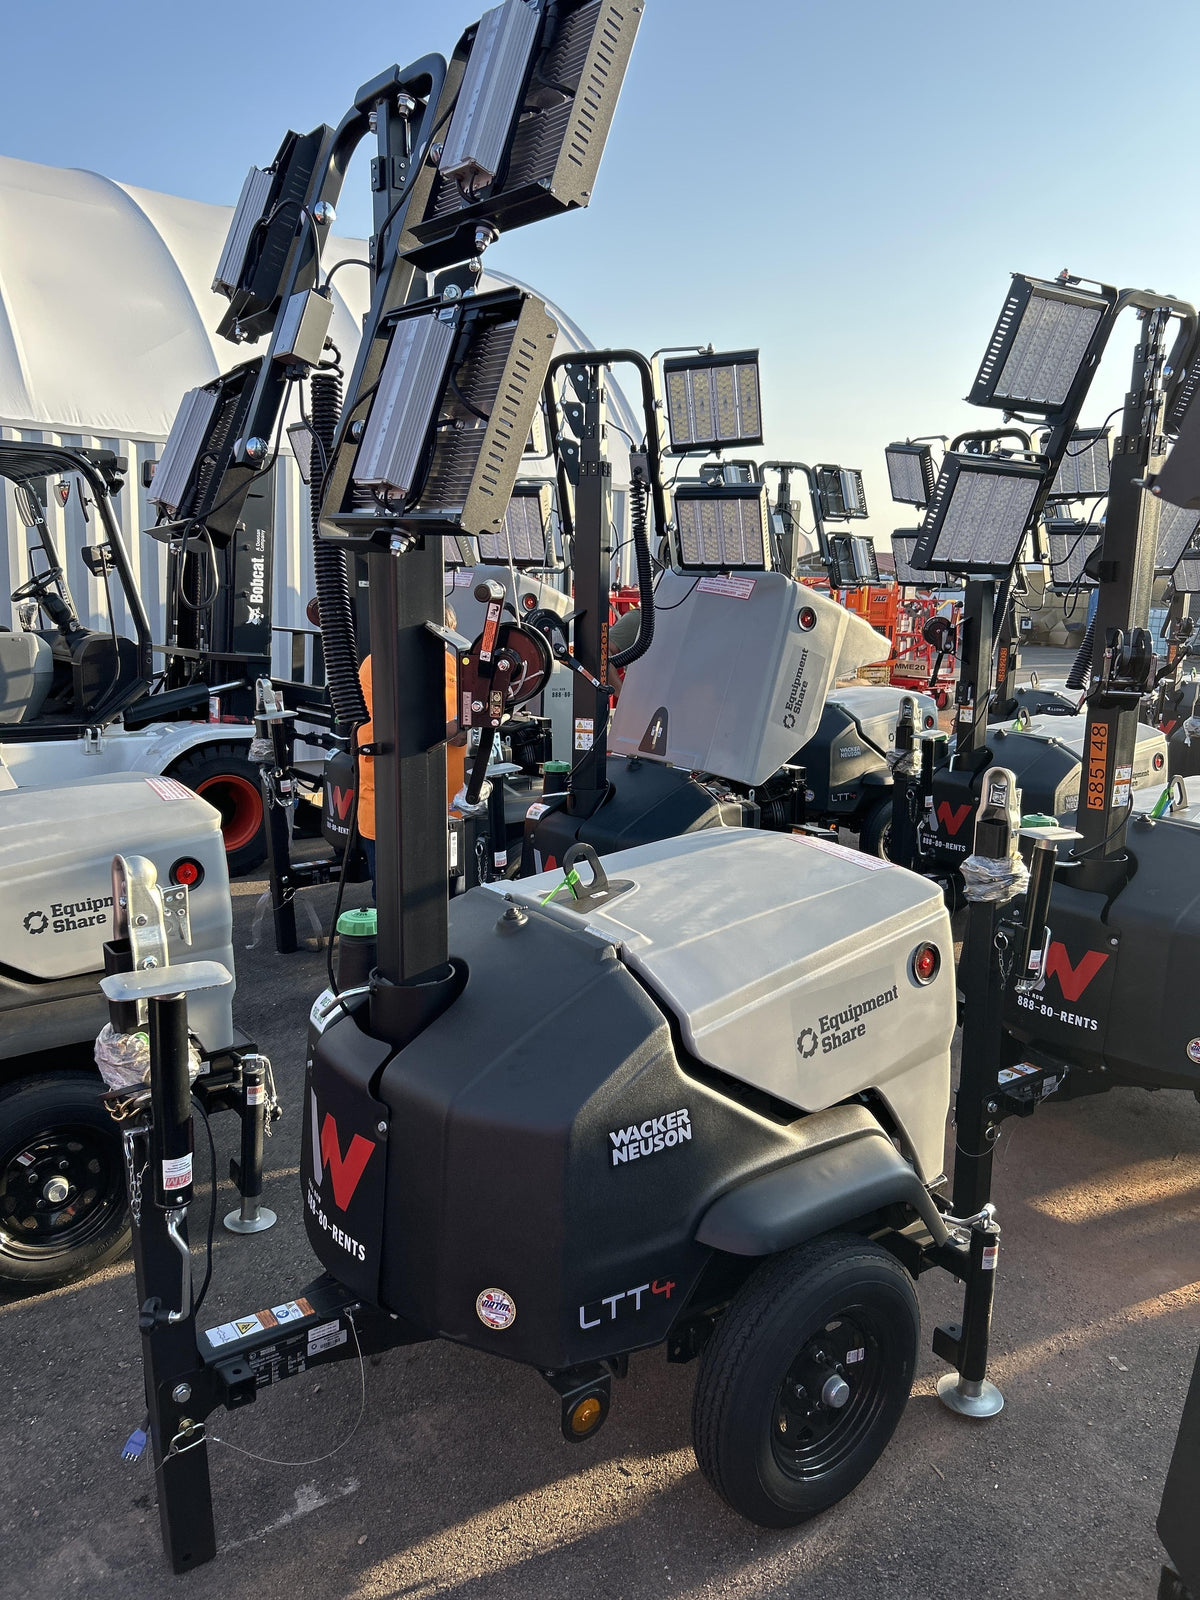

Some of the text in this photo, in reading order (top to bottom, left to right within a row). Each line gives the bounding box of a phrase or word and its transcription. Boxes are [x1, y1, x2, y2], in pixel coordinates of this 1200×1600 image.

[250, 557, 265, 604] Bobcat
[785, 647, 809, 712] Equipment
[894, 662, 926, 671] MME20
[793, 680, 809, 715] Share
[840, 745, 860, 754] WACKER
[840, 751, 861, 759] NEUSON
[1088, 726, 1107, 808] 585148
[52, 913, 107, 934] Share
[818, 984, 899, 1035] Equipment
[1017, 995, 1099, 1032] 888-80-RENTS
[820, 1022, 867, 1055] Share
[608, 1108, 692, 1148] WACKER
[612, 1123, 693, 1166] NEUSON
[307, 1188, 367, 1262] 888-80-RENTS
[579, 1279, 677, 1330] LTT4
